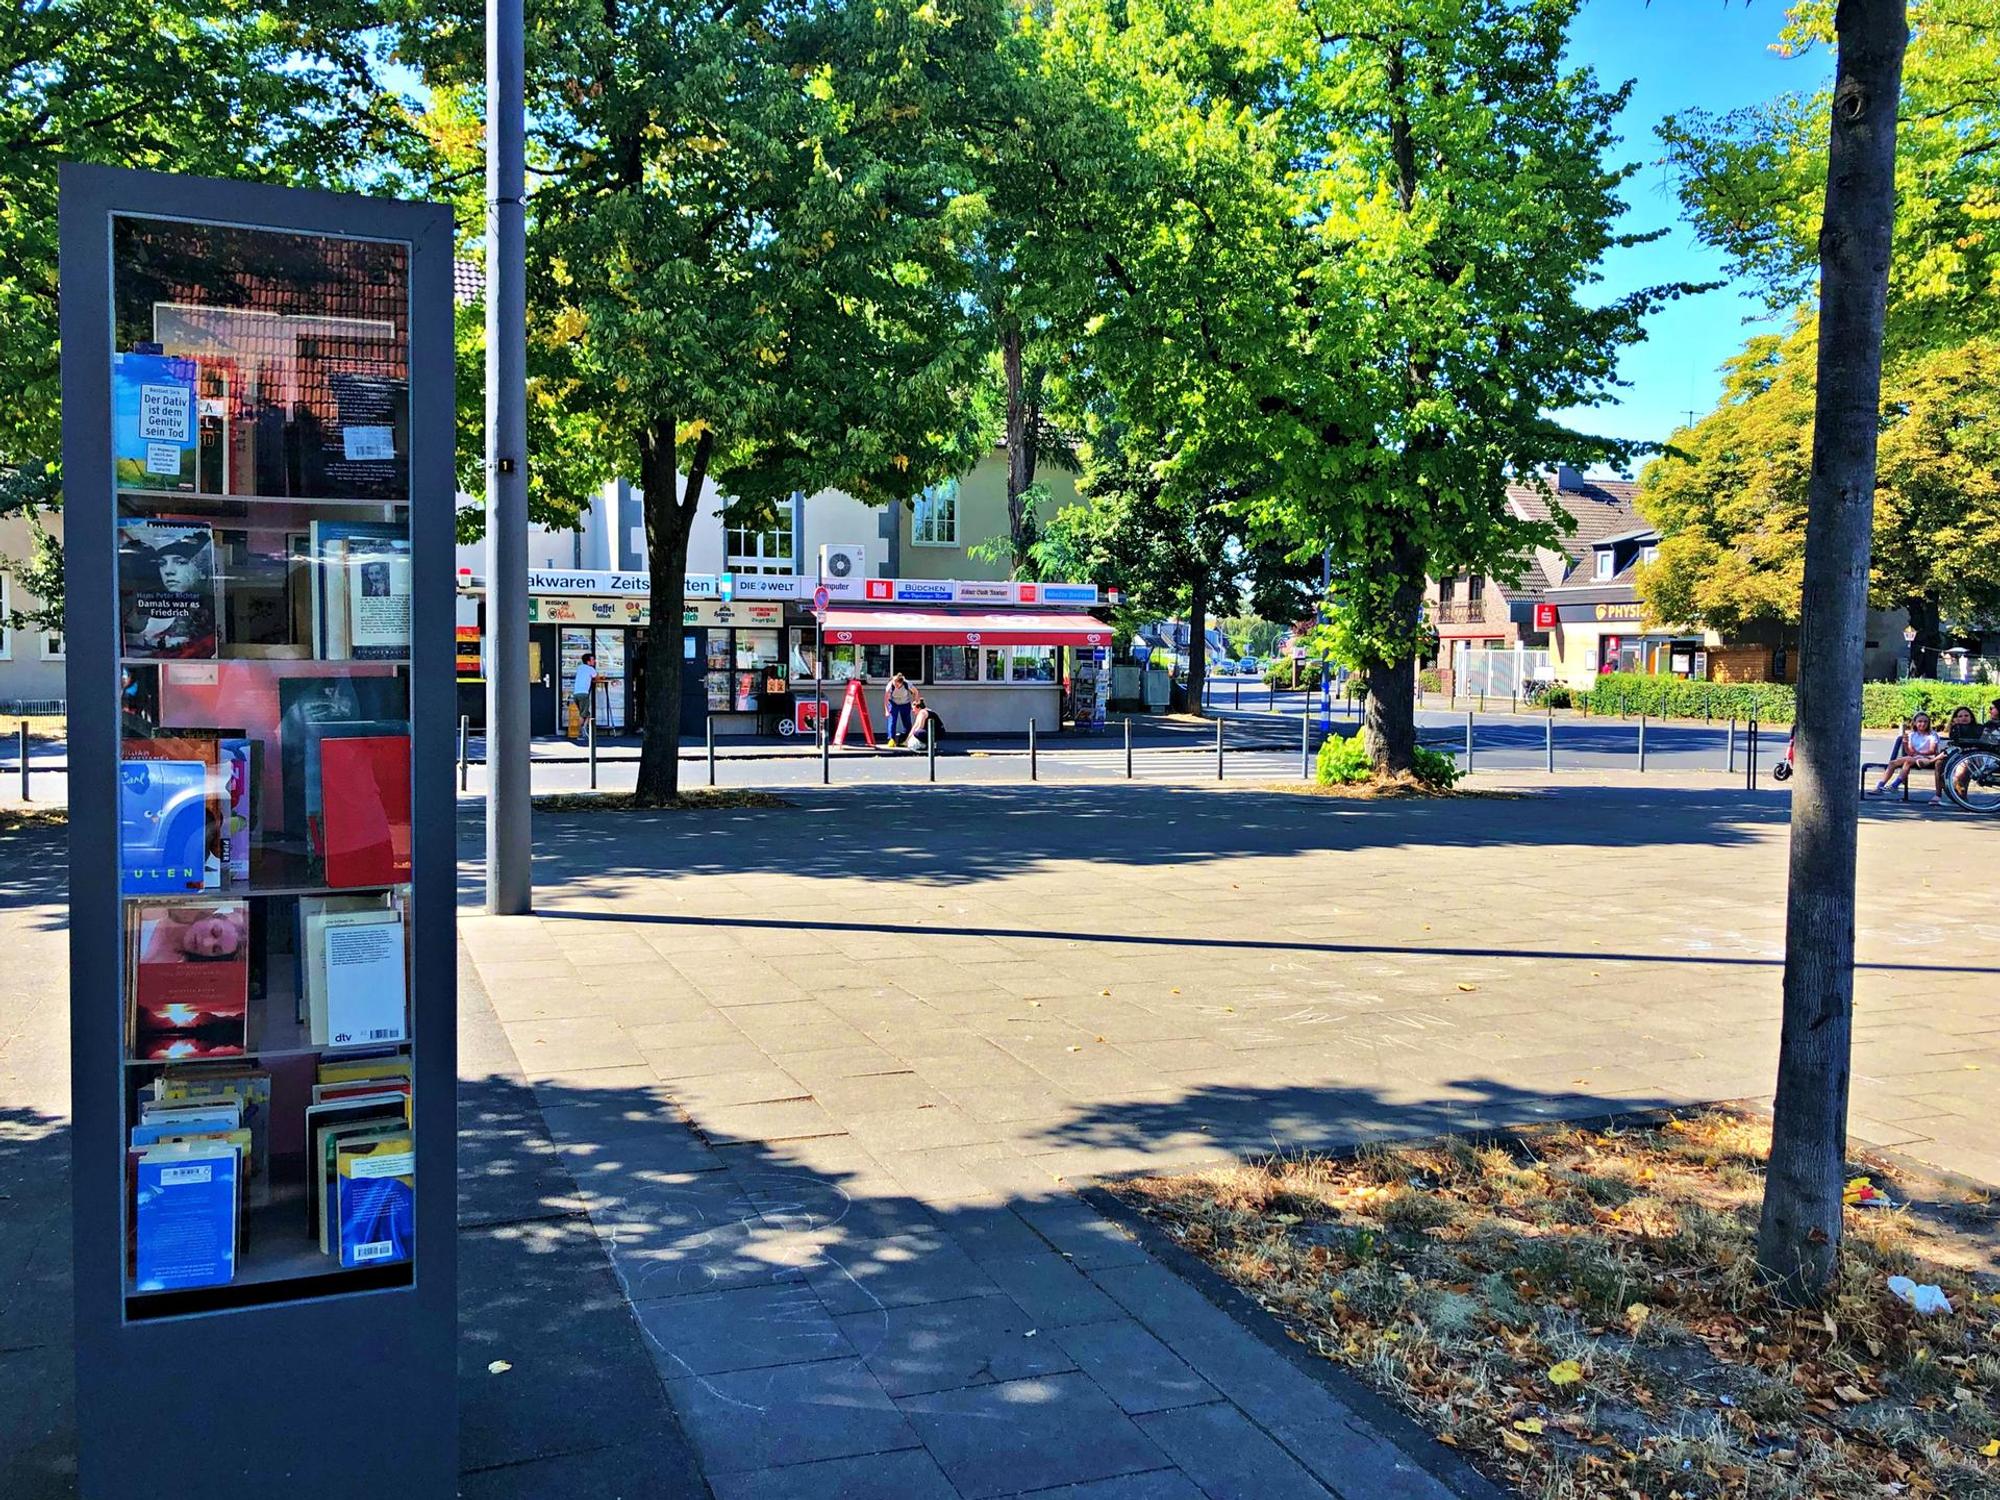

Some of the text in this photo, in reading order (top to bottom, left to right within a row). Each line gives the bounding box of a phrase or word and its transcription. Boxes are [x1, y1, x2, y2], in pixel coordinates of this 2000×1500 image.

[144, 394, 187, 407] Der Dativ
[148, 404, 183, 417] ist dem
[148, 415, 182, 427] Genitiv
[145, 427, 184, 438] sein Tod
[740, 581, 756, 590] DIE
[905, 583, 946, 592] BÜDCHEN
[138, 599, 170, 608] Damals
[592, 603, 616, 614] Gaffel
[150, 608, 189, 617] Friedrich
[334, 1032, 352, 1043] dtv
